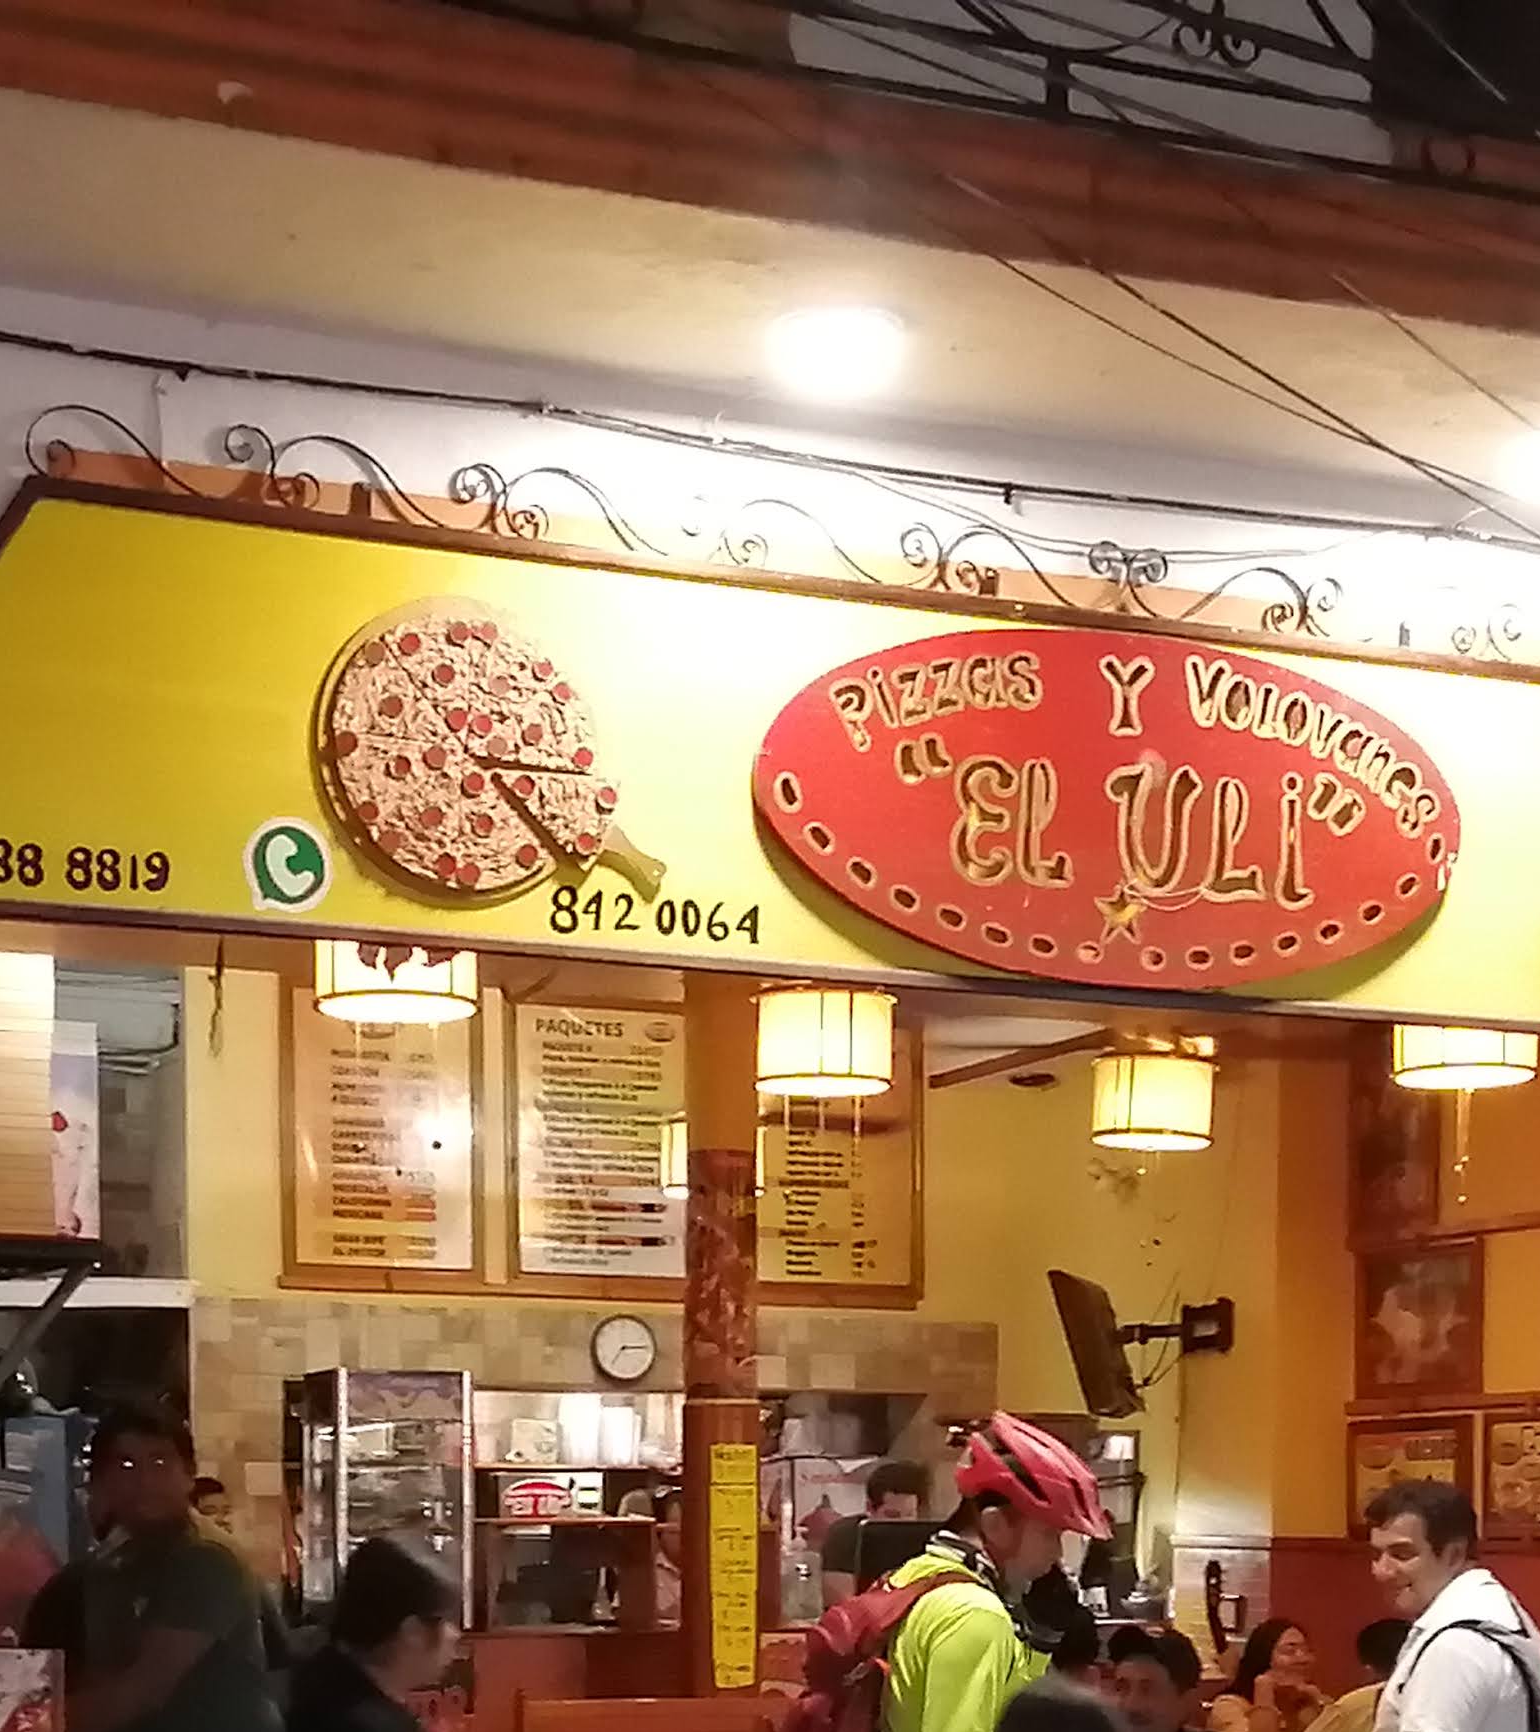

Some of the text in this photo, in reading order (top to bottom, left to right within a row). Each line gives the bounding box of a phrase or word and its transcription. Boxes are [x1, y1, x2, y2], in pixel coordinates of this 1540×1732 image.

[1099, 654, 1155, 737] Y
[65, 846, 170, 892] 8819
[549, 885, 760, 945] 842 0064
[535, 1018, 625, 1038] PAQUETES
